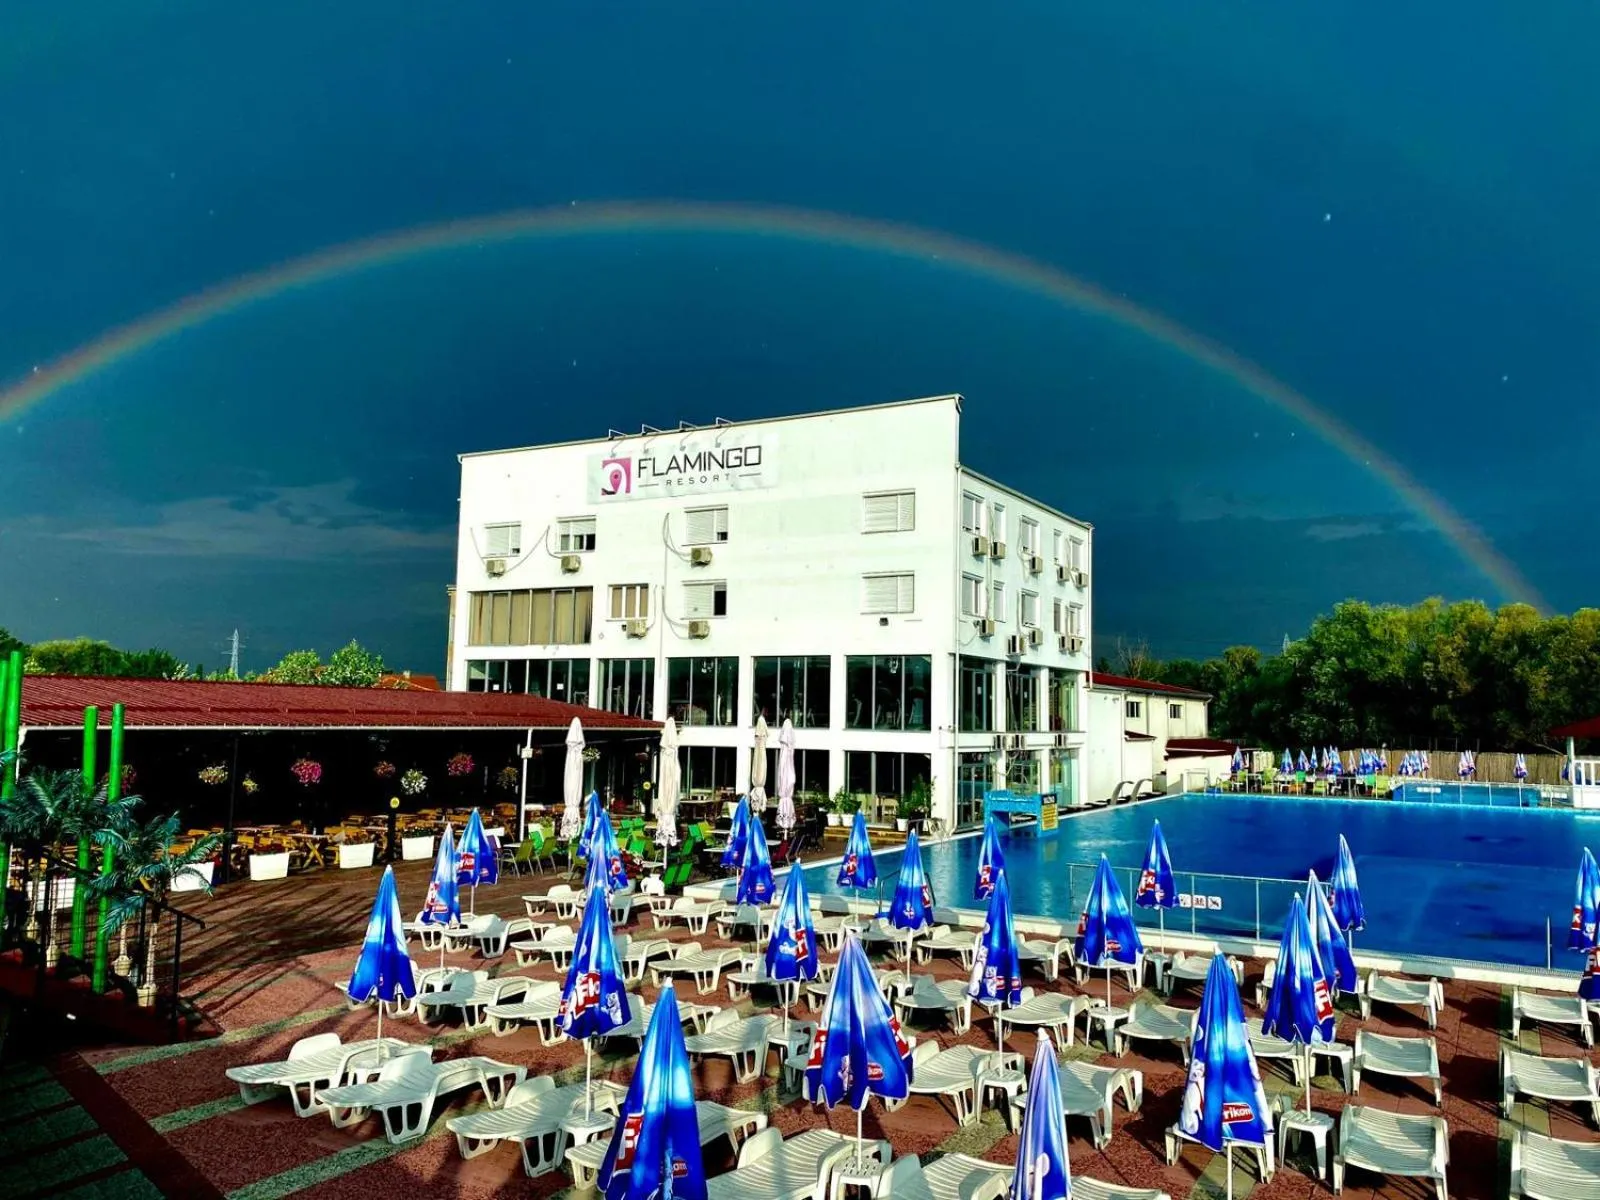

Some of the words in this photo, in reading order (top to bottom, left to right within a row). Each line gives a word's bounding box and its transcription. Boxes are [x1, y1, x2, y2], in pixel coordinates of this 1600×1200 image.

[638, 445, 762, 478] FLAMINGO
[665, 473, 731, 486] RESORT
[1222, 1106, 1252, 1120] rikom
